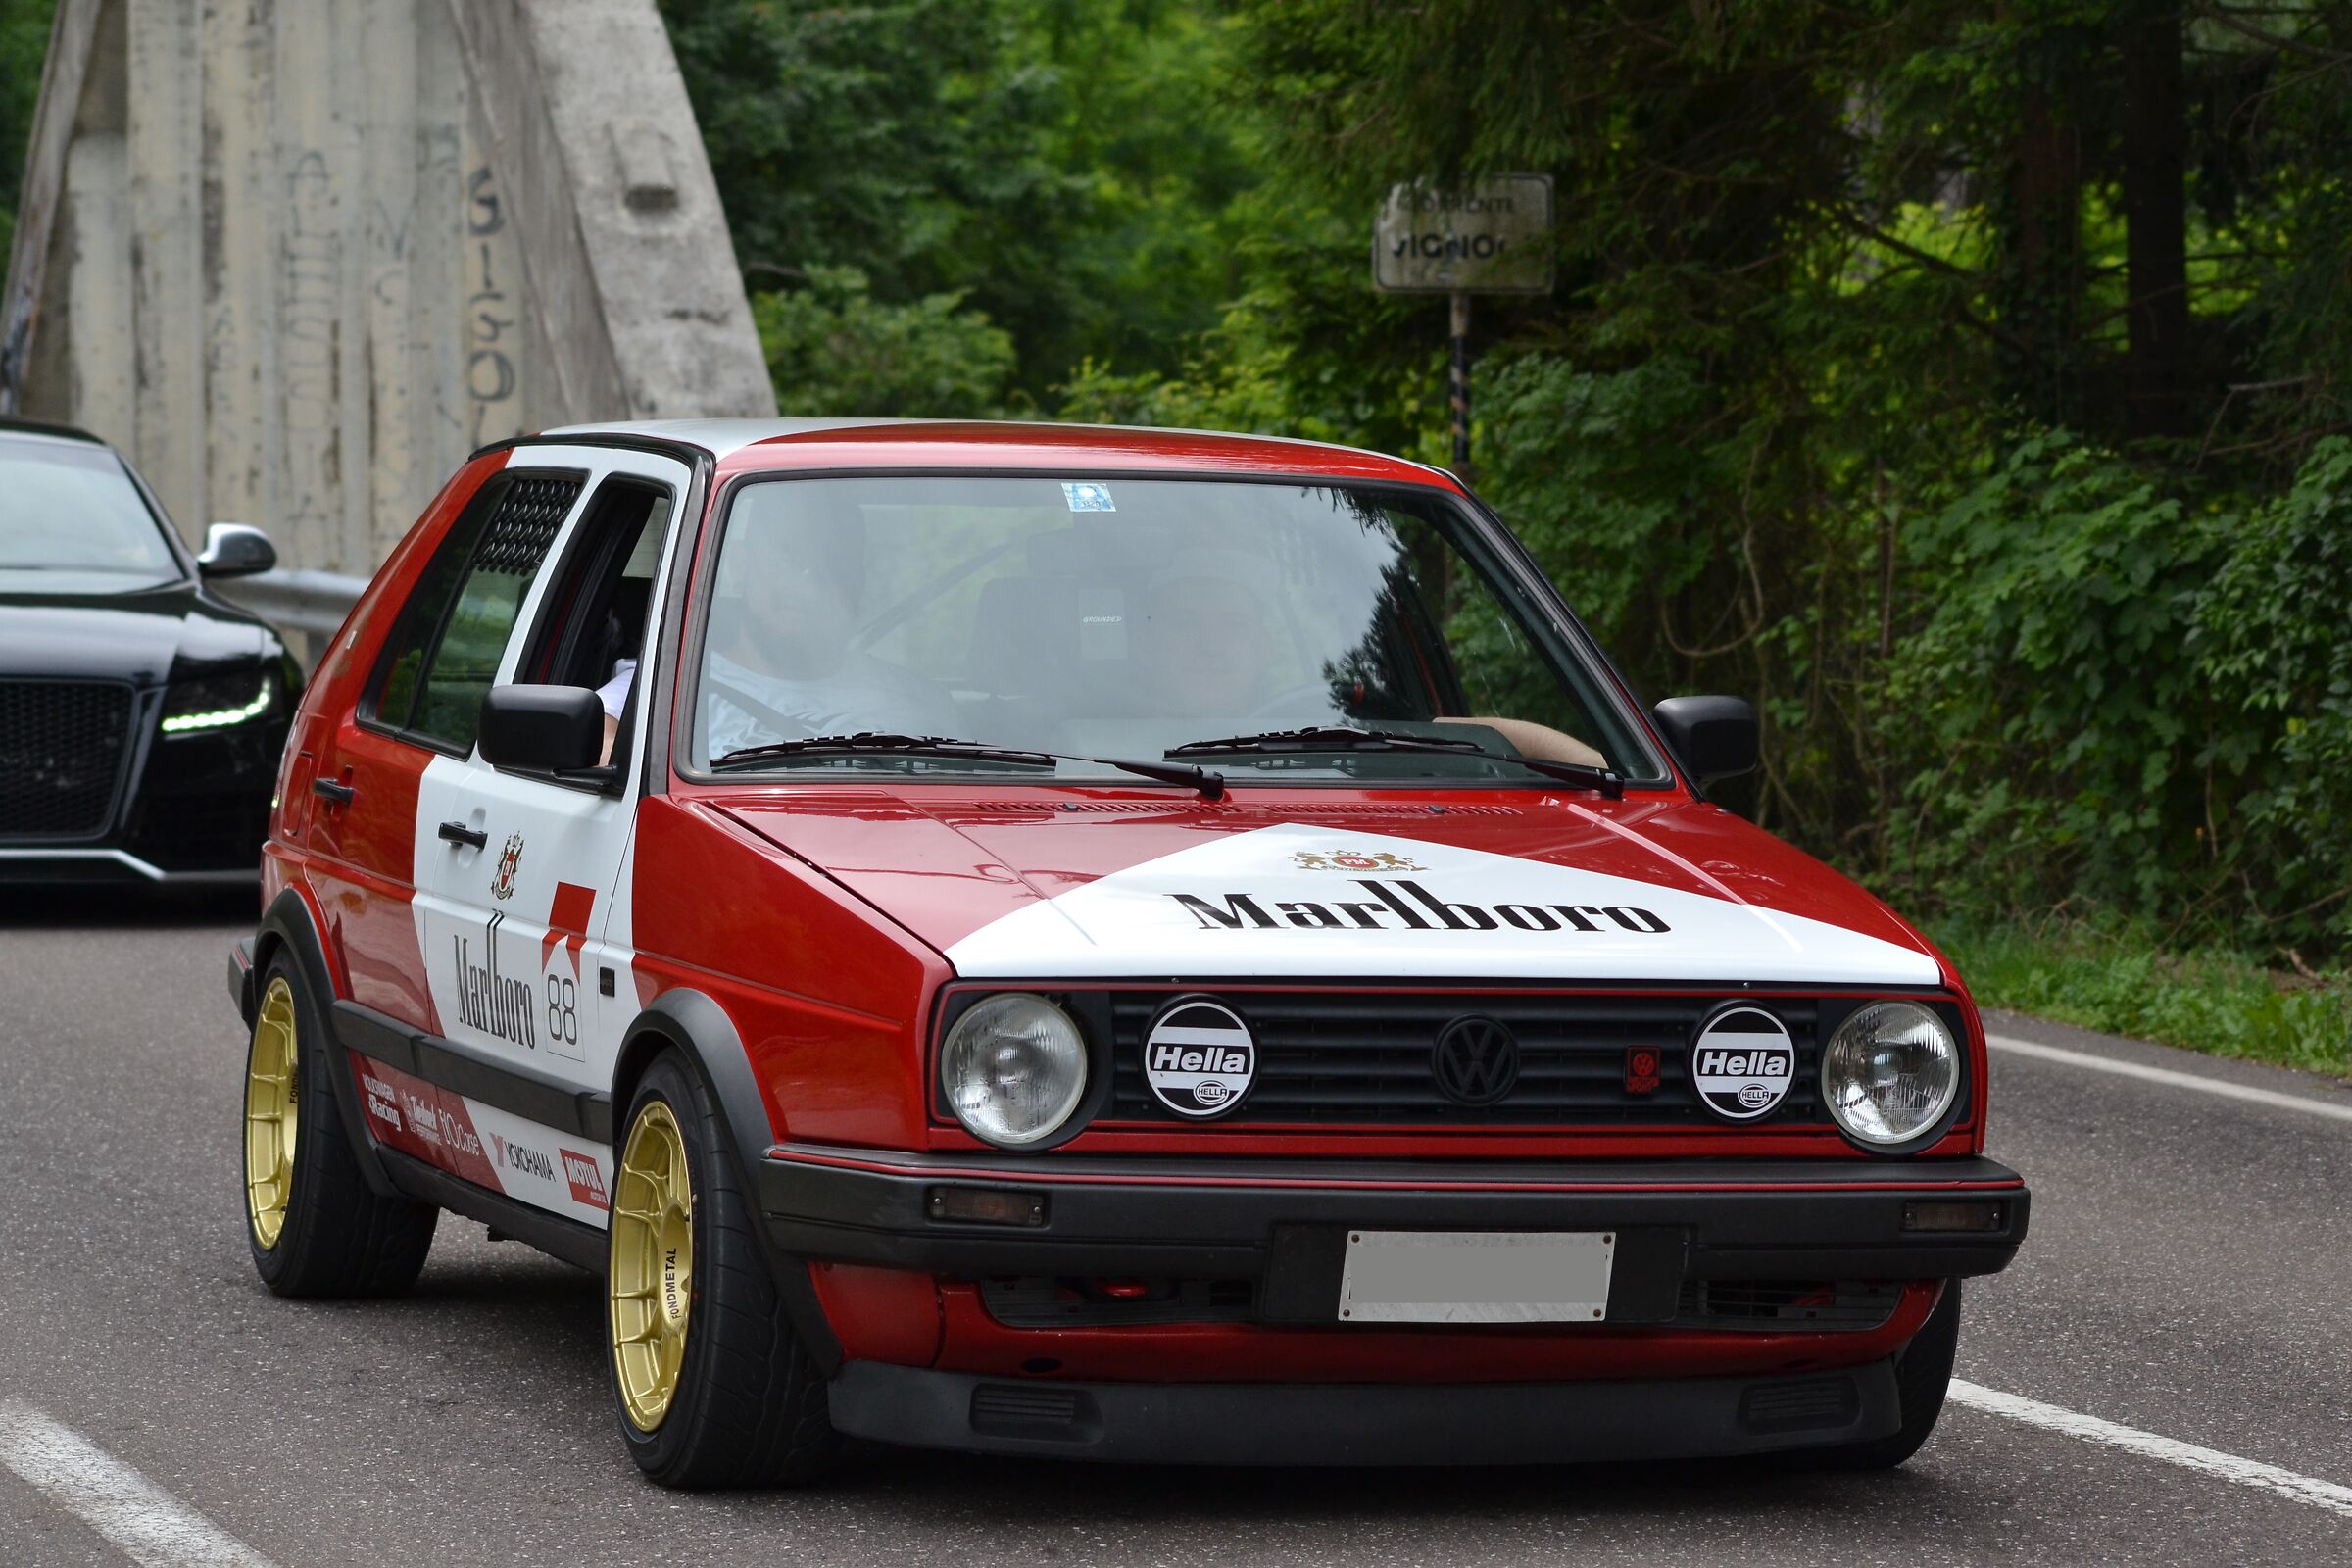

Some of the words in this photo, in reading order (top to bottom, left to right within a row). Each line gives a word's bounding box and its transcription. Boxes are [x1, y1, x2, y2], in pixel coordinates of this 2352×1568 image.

[1342, 858, 1370, 867] PM
[1163, 879, 1672, 934] Marlboro
[453, 908, 536, 1050] Marlboro
[547, 973, 577, 1046] 88
[1153, 1046, 1246, 1073] Hella
[1701, 1051, 1787, 1076] Hella
[1198, 1087, 1228, 1097] HELLA
[1742, 1091, 1769, 1100] HELLA
[368, 1093, 402, 1132] Racing
[504, 1140, 557, 1183] YOKOHAMA
[564, 1156, 604, 1193] MOTUL
[665, 1248, 682, 1321] FONDMETAL
